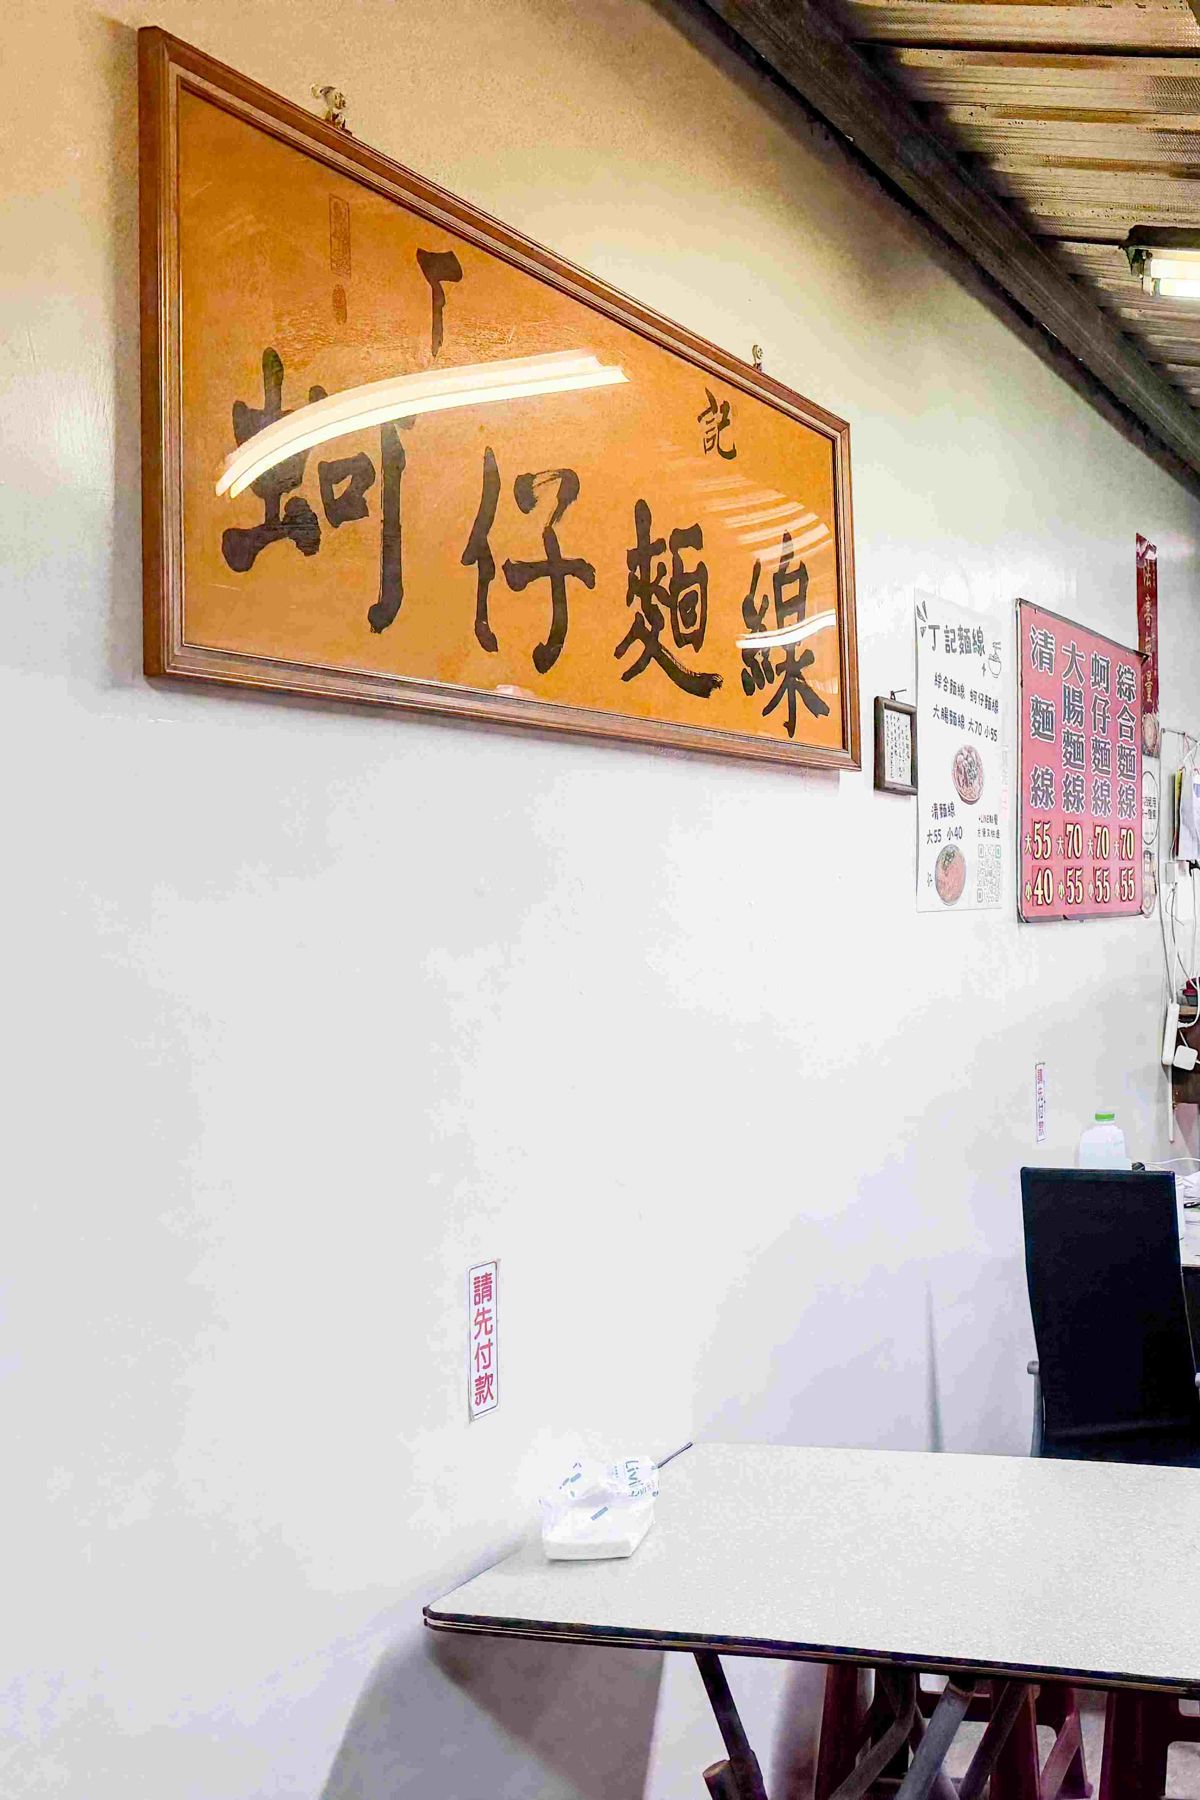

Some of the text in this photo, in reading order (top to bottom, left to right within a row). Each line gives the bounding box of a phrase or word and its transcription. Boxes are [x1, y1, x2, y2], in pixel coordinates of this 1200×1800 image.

[928, 624, 985, 657] 丁記麵線
[1029, 624, 1056, 809] 清麵線
[1062, 640, 1086, 813] 大腸麵線
[1090, 651, 1112, 817] 蚵仔麵線
[1115, 662, 1137, 819] 綜合麵線
[473, 1272, 494, 1407] 請先付款
